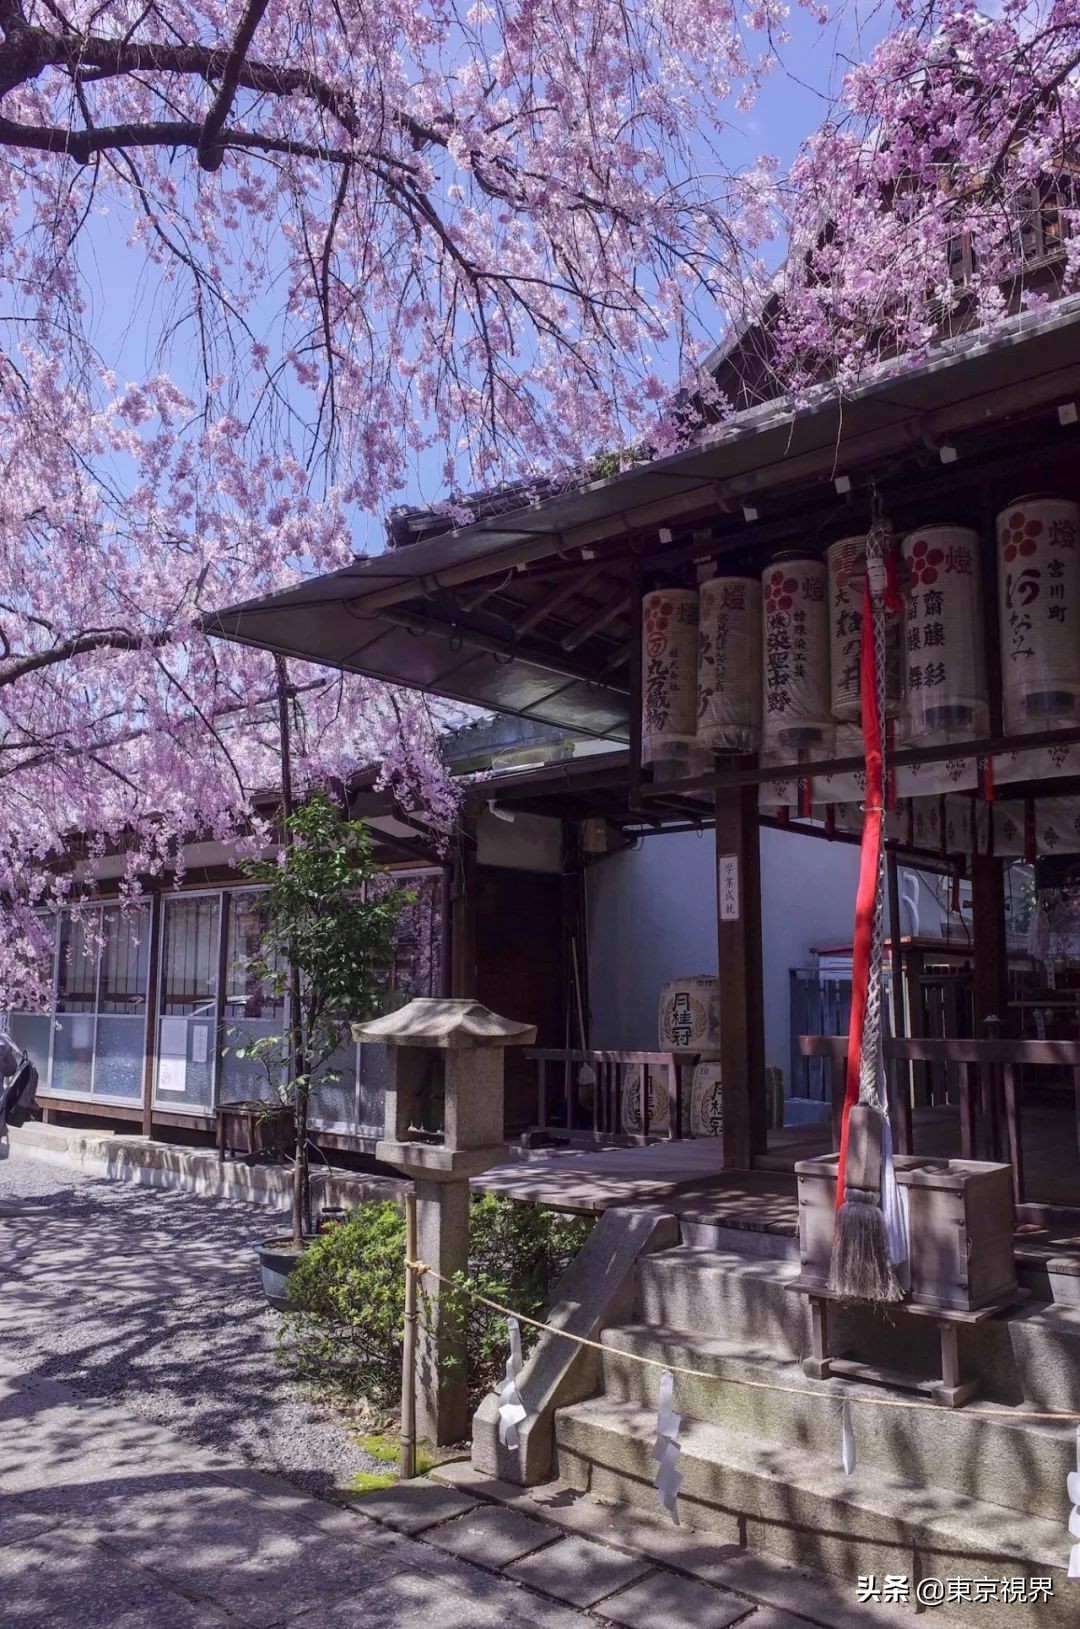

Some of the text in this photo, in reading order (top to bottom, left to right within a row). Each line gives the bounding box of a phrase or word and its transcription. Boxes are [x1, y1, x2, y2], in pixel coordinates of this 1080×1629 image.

[1047, 559, 1067, 622] 宮川町
[671, 992, 693, 1047] 月桂冠
